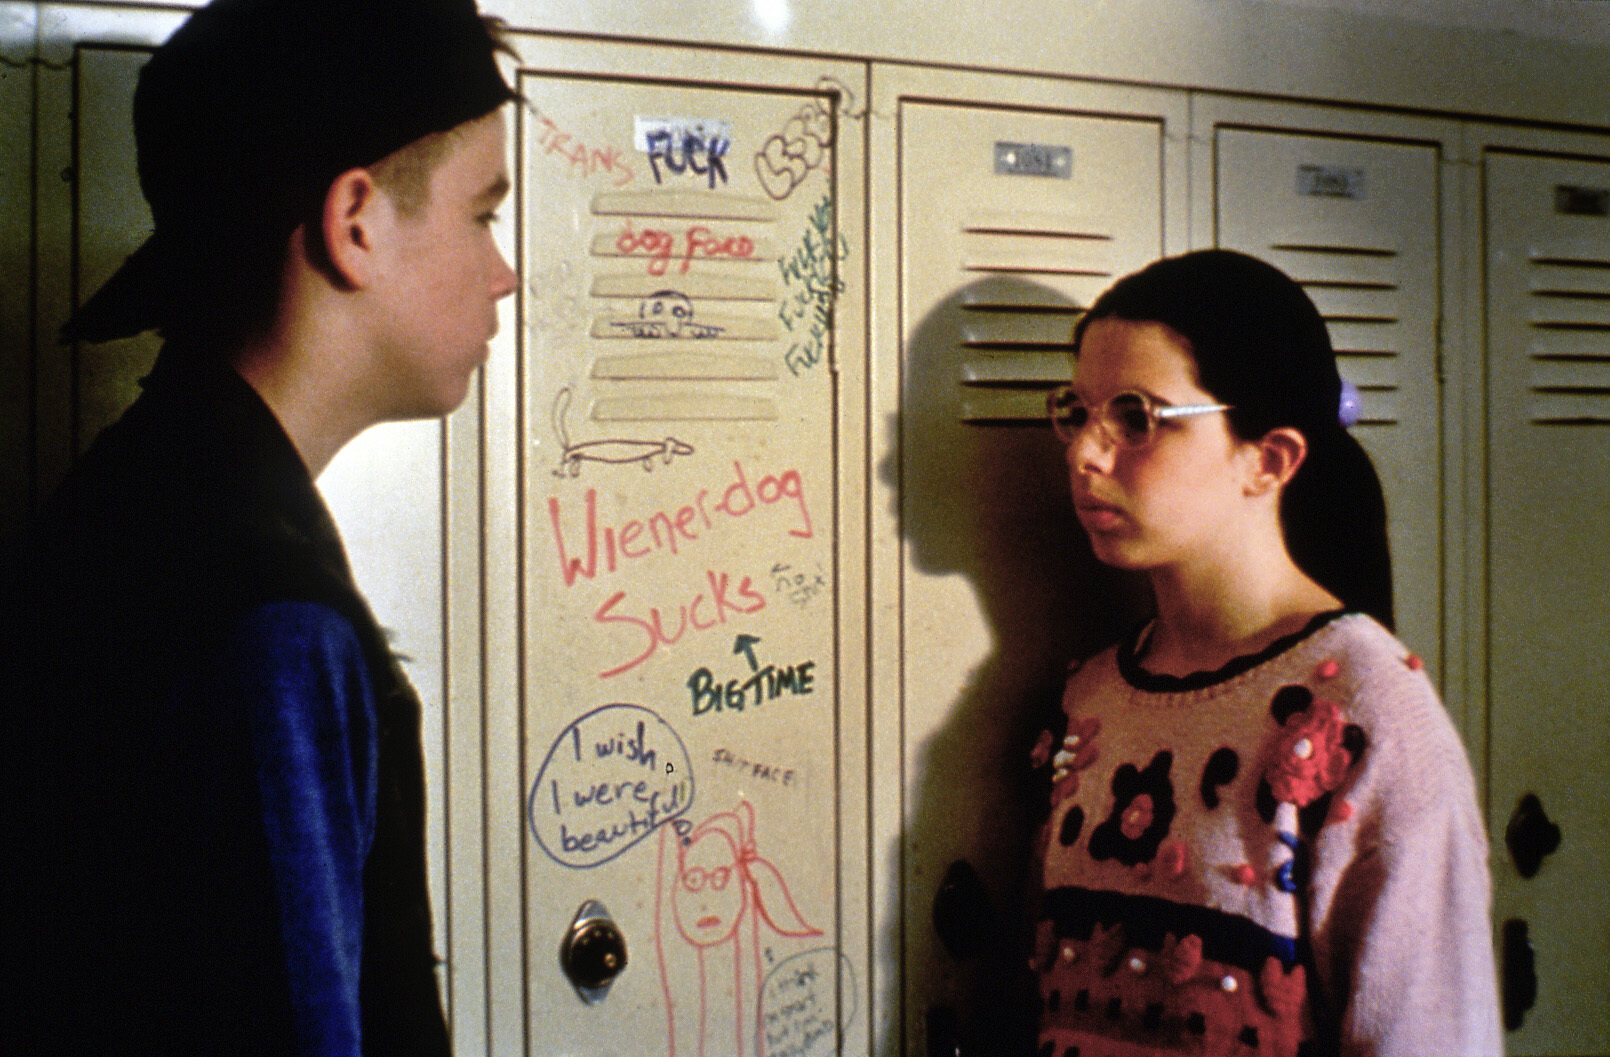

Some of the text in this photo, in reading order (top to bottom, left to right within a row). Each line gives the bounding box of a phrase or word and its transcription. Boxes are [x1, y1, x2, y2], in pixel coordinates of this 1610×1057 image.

[646, 129, 730, 189] FUCK
[616, 219, 673, 276] dog
[596, 721, 655, 770] wish
[574, 780, 649, 807] were
